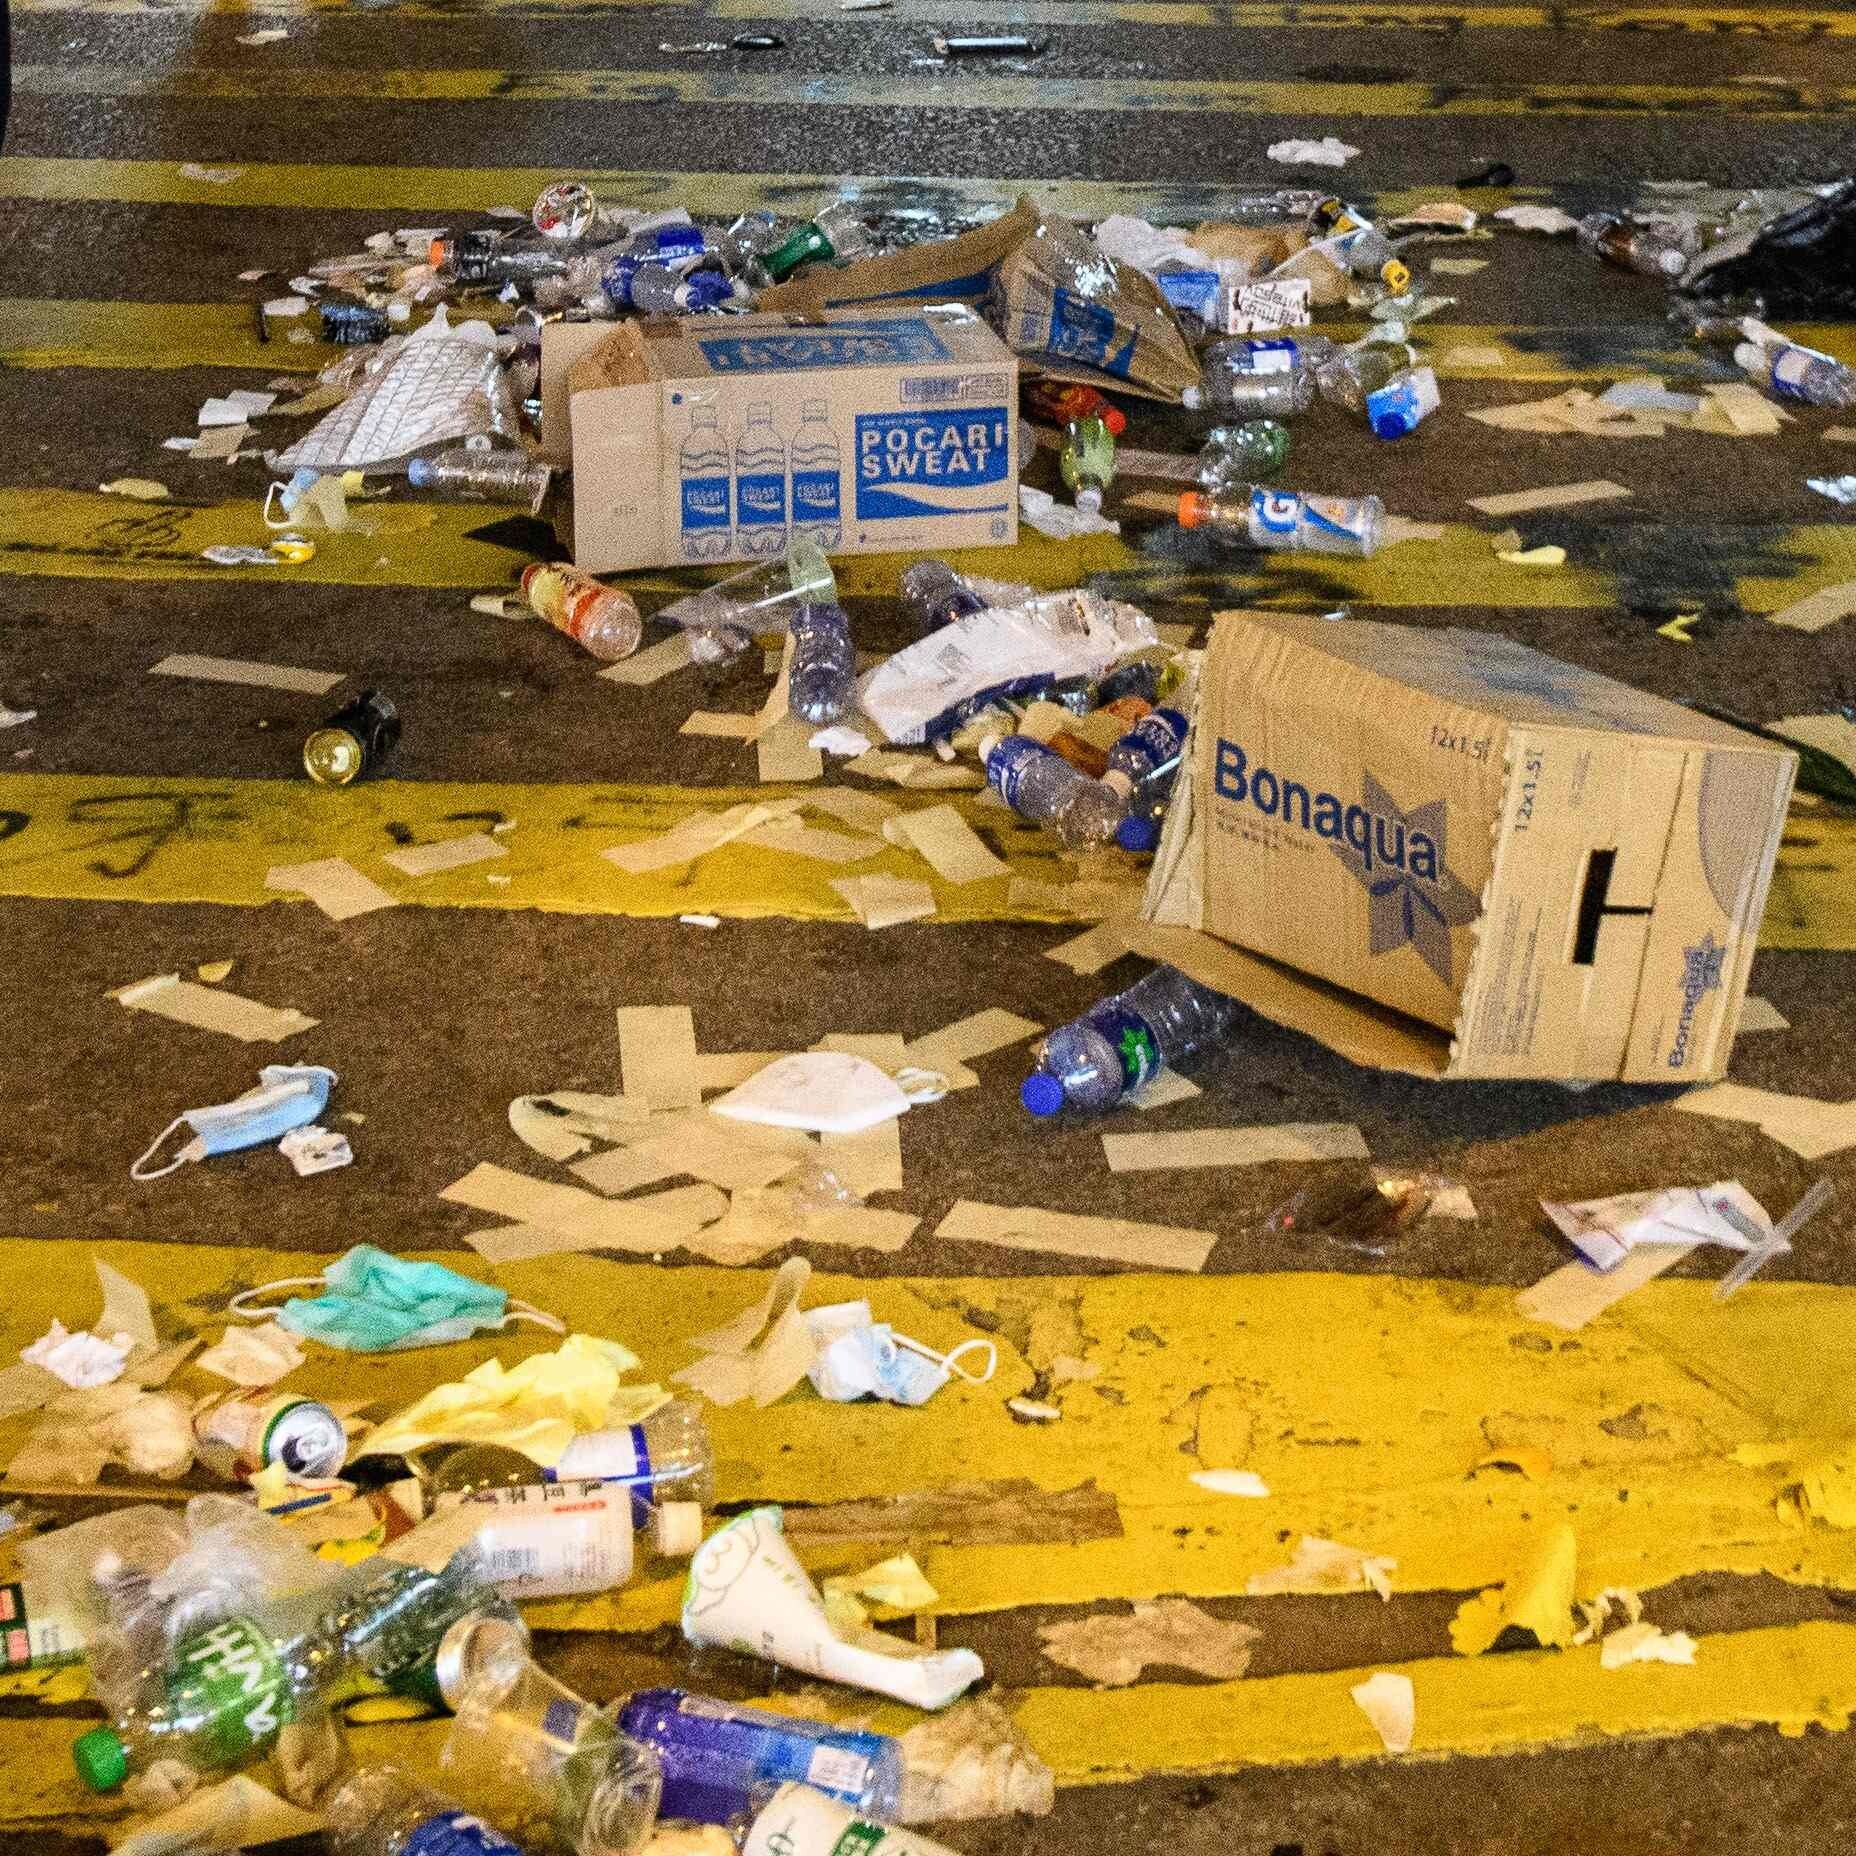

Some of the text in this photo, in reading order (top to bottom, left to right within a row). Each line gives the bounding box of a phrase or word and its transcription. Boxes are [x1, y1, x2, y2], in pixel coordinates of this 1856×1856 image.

[860, 424, 1006, 454] POCARI
[861, 446, 992, 479] SWEAT
[1213, 736, 1438, 882] Bonaqua
[1667, 950, 1706, 1070] Bonaqua
